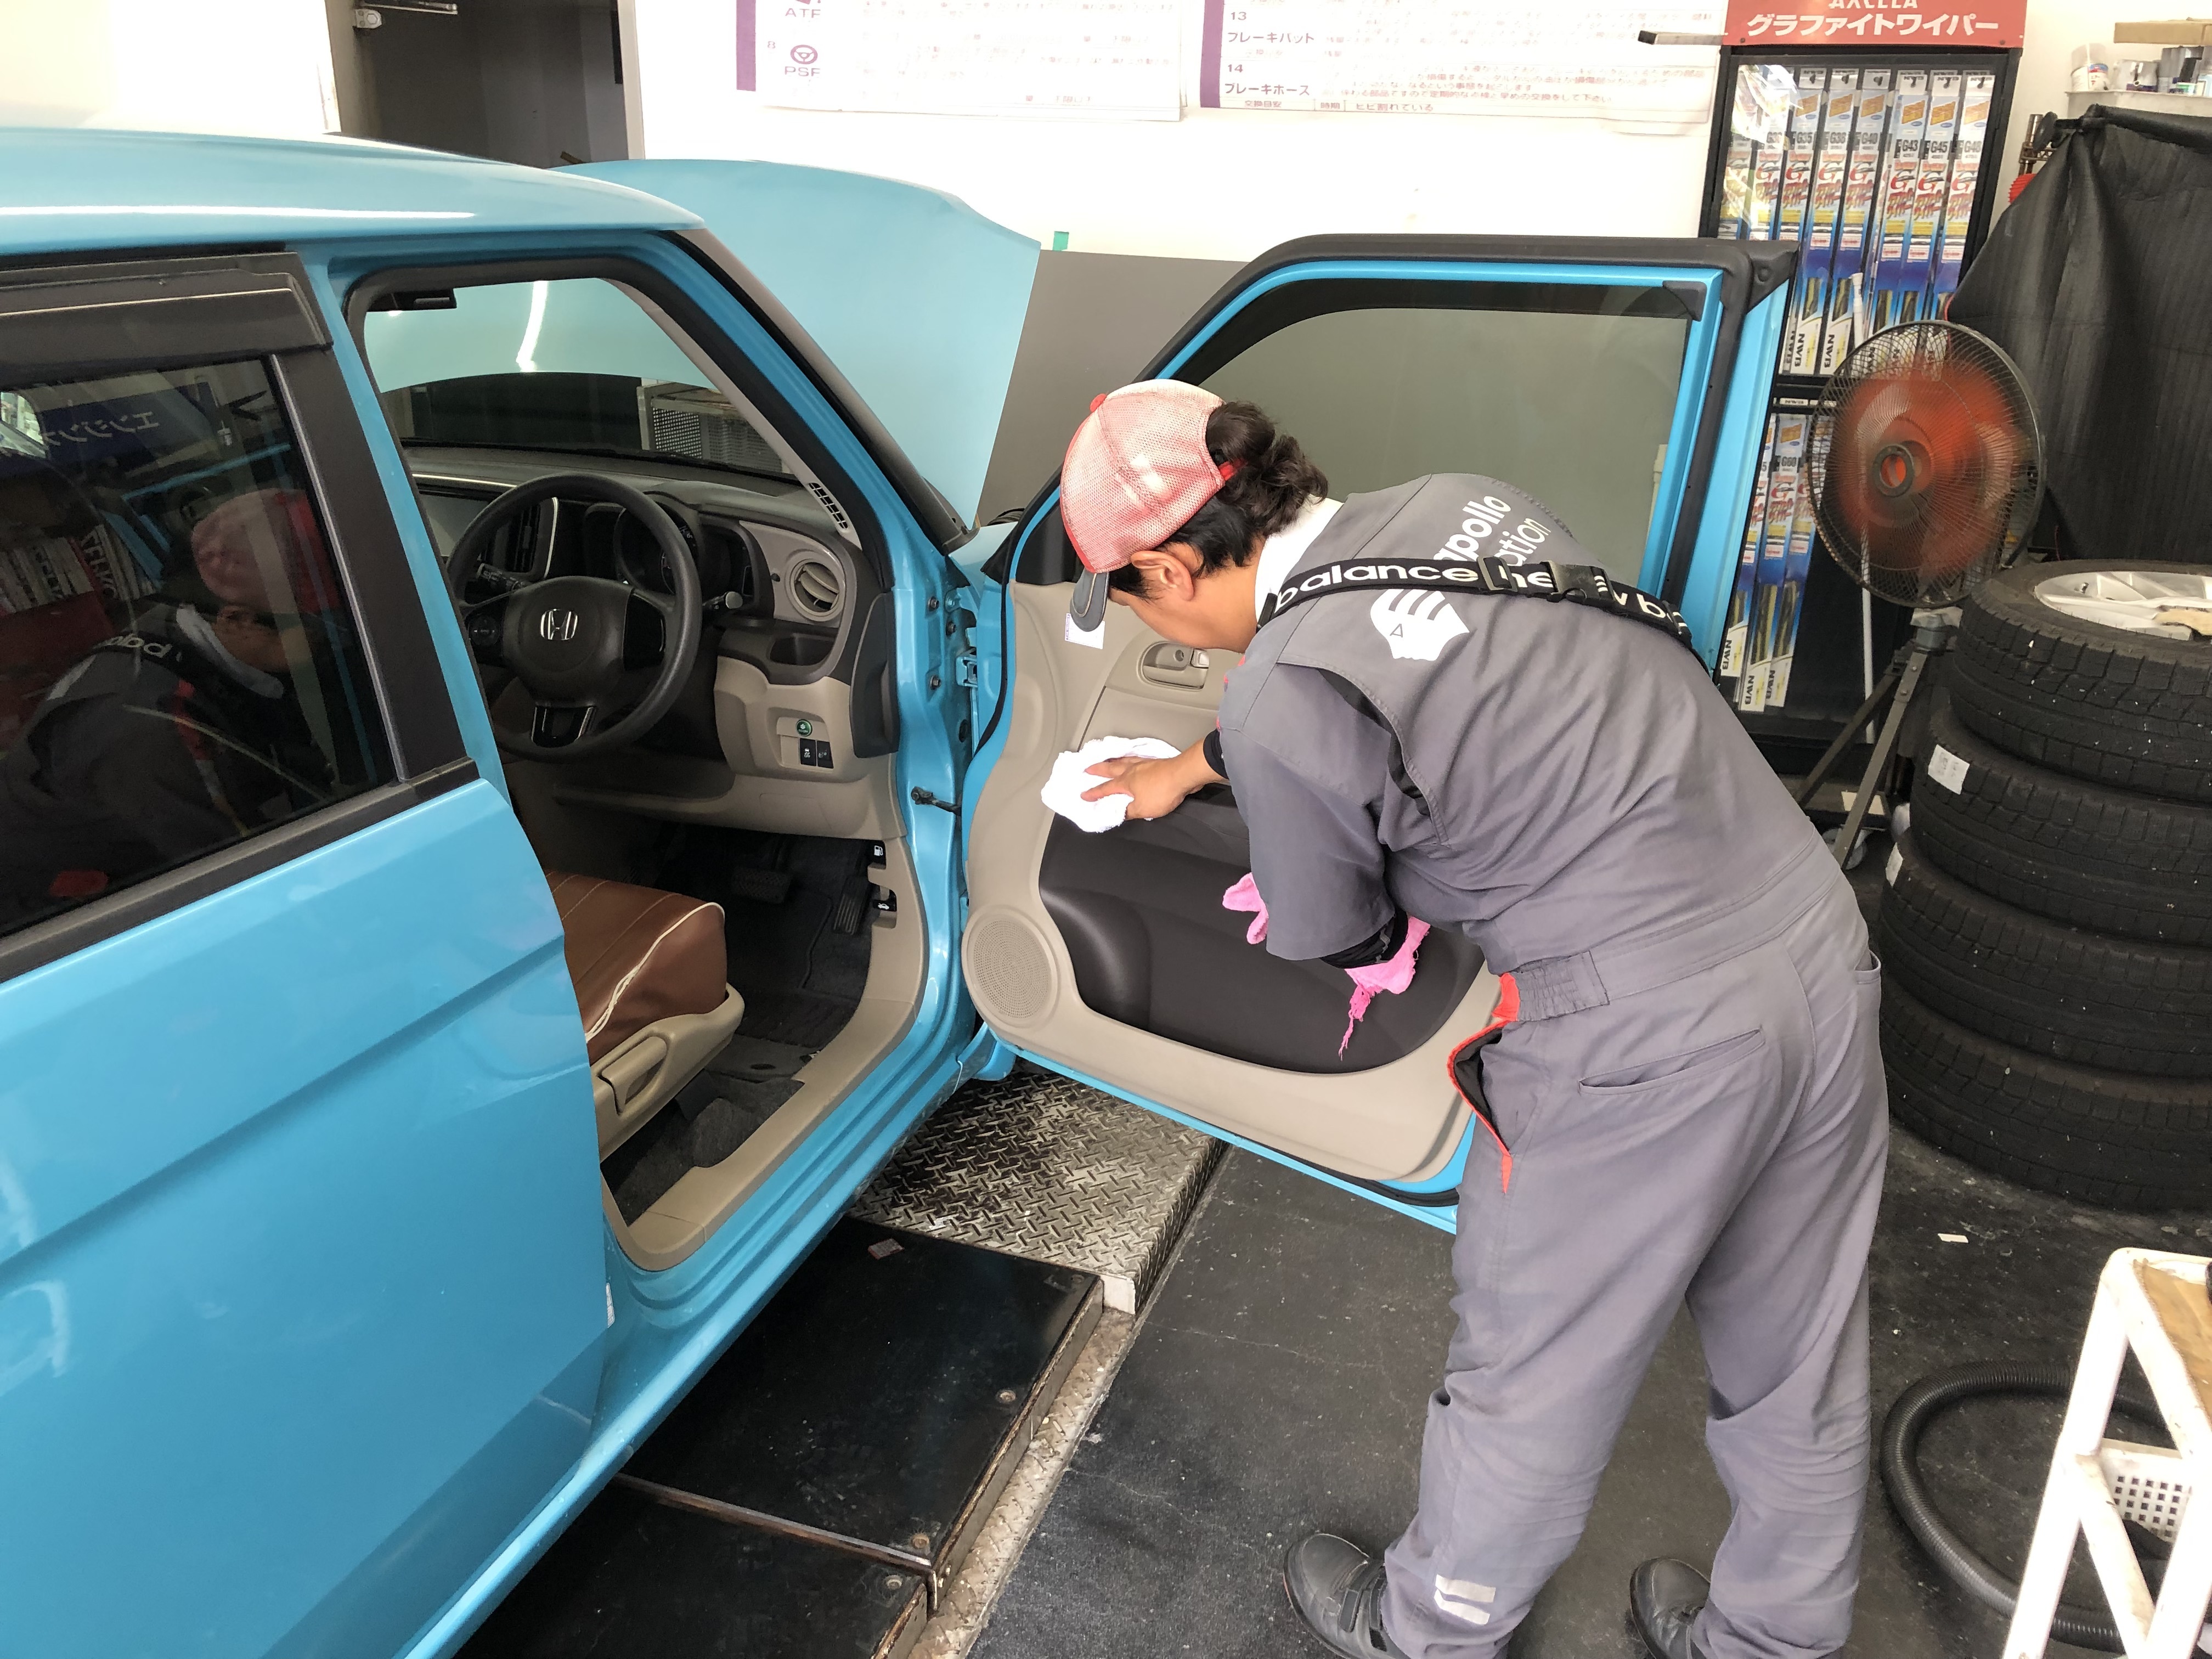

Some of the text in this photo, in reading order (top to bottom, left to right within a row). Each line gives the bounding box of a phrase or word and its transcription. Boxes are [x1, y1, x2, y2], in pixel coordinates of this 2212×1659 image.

[785, 8, 821, 19] ATF
[1231, 12, 1247, 21] 13
[1747, 13, 1999, 37] グラファイトワイパー
[767, 41, 776, 49] 8
[785, 66, 821, 77] PSF
[1228, 64, 1244, 73] 14
[1274, 565, 1479, 614] balance
